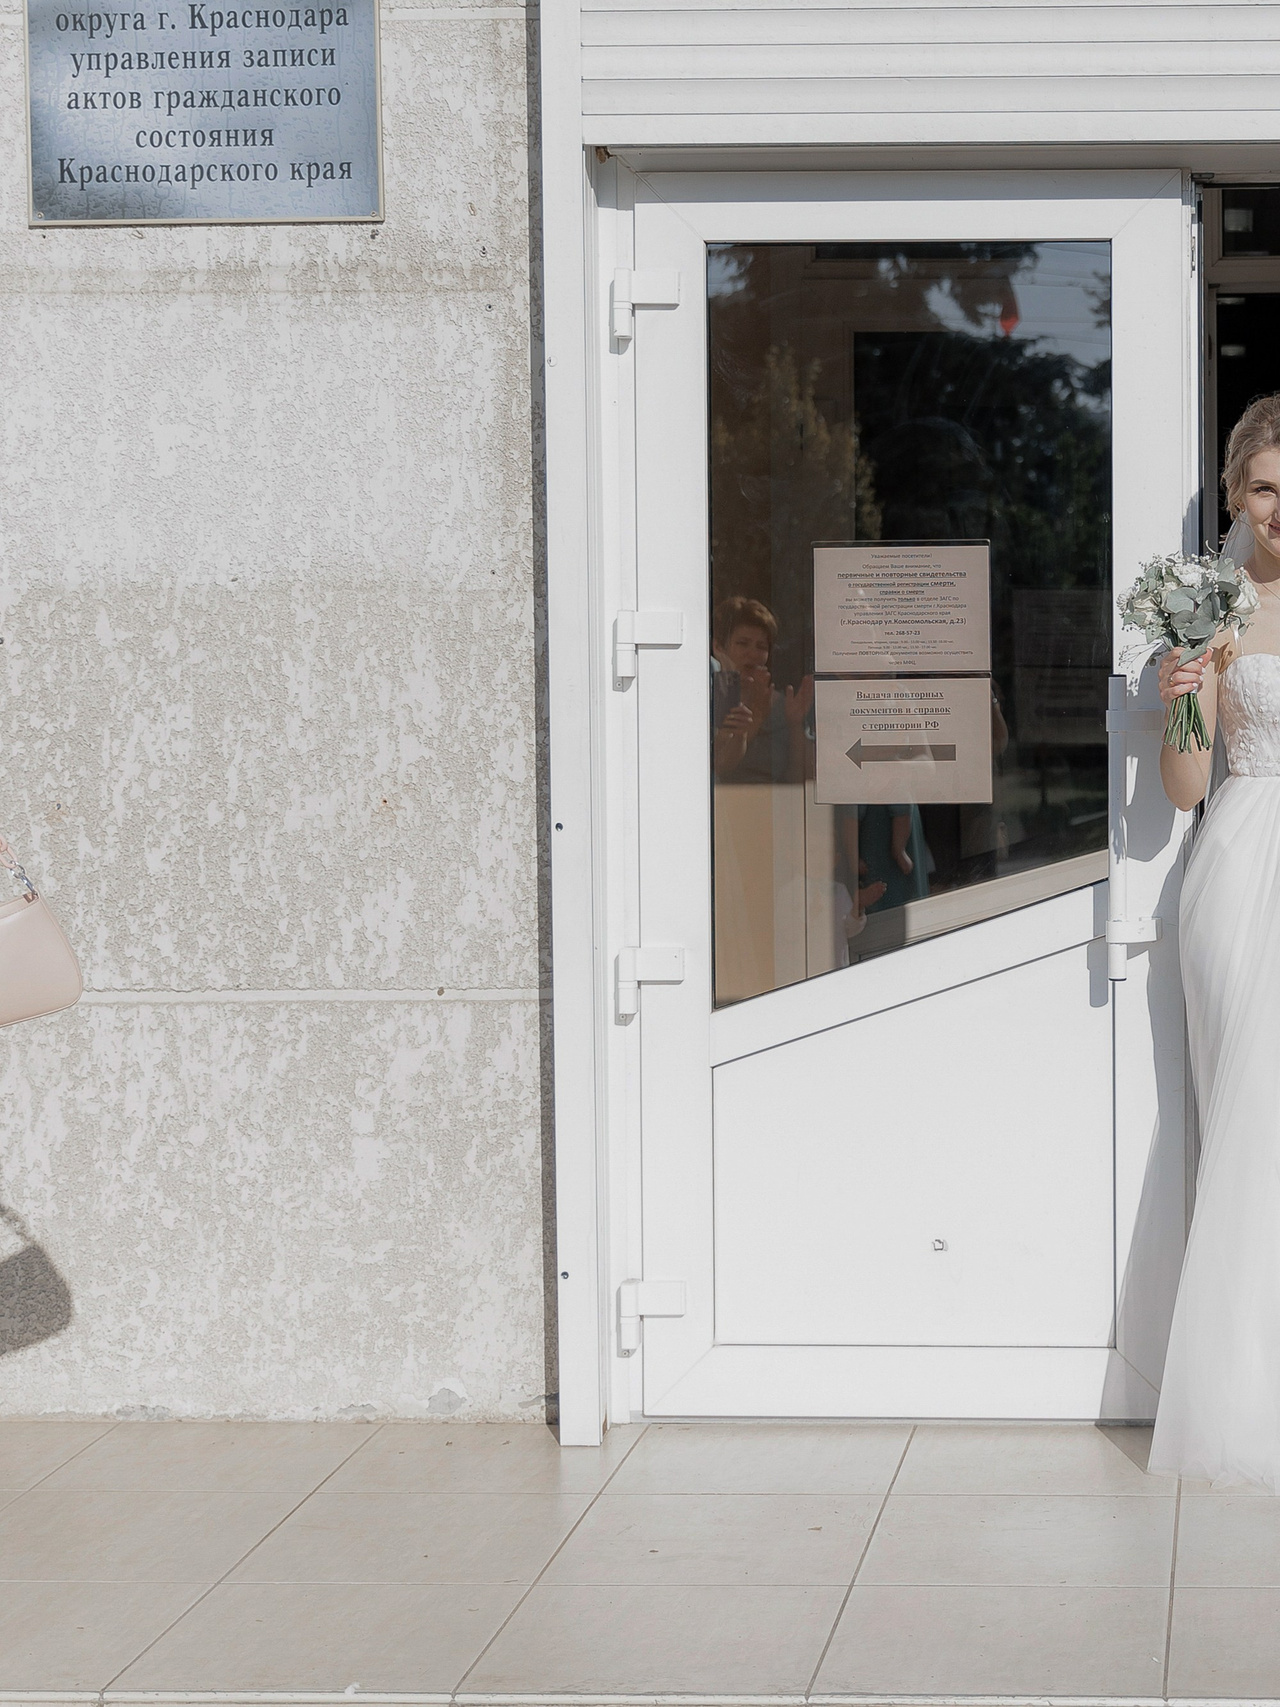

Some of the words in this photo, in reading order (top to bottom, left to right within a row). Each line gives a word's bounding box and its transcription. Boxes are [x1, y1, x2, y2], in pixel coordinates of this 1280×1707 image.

[55, 12, 147, 40] округа
[157, 13, 177, 31] г.
[188, 3, 350, 37] Краснодара
[70, 50, 232, 79] управления
[243, 47, 336, 68] записи
[66, 91, 142, 110] актов
[153, 86, 341, 117] гражданского
[135, 128, 275, 149] состояния
[57, 157, 279, 191] Краснодарского
[289, 161, 353, 188] края
[840, 618, 884, 626] (г.Краснодар
[856, 691, 891, 700] Выдача
[893, 690, 944, 700] повторных
[850, 707, 903, 716] документов
[913, 706, 951, 715] справок
[868, 722, 922, 731] территории
[924, 720, 940, 730] РФ
